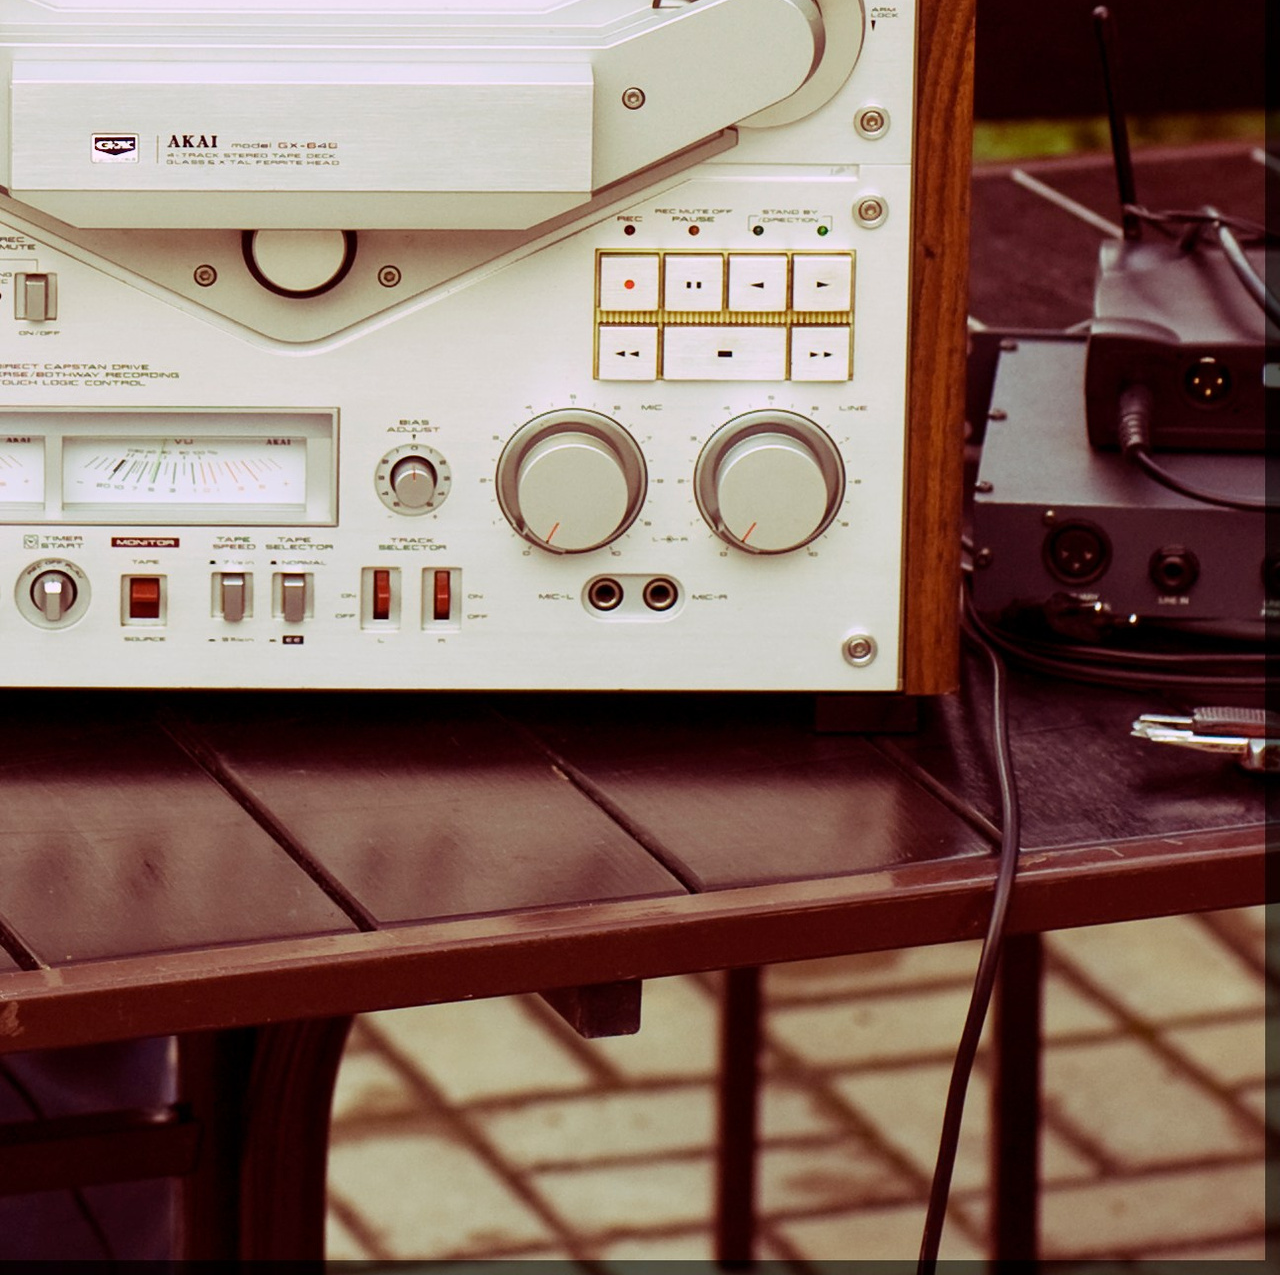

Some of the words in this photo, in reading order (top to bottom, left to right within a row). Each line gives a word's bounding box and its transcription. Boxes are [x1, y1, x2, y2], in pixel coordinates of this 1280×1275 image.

[167, 135, 218, 148] AKAI
[105, 371, 180, 379] RECORDING
[27, 563, 41, 576] REC
[65, 563, 83, 579] PLAY
[1158, 596, 1176, 605] LINE
[1180, 596, 1189, 604] IN
